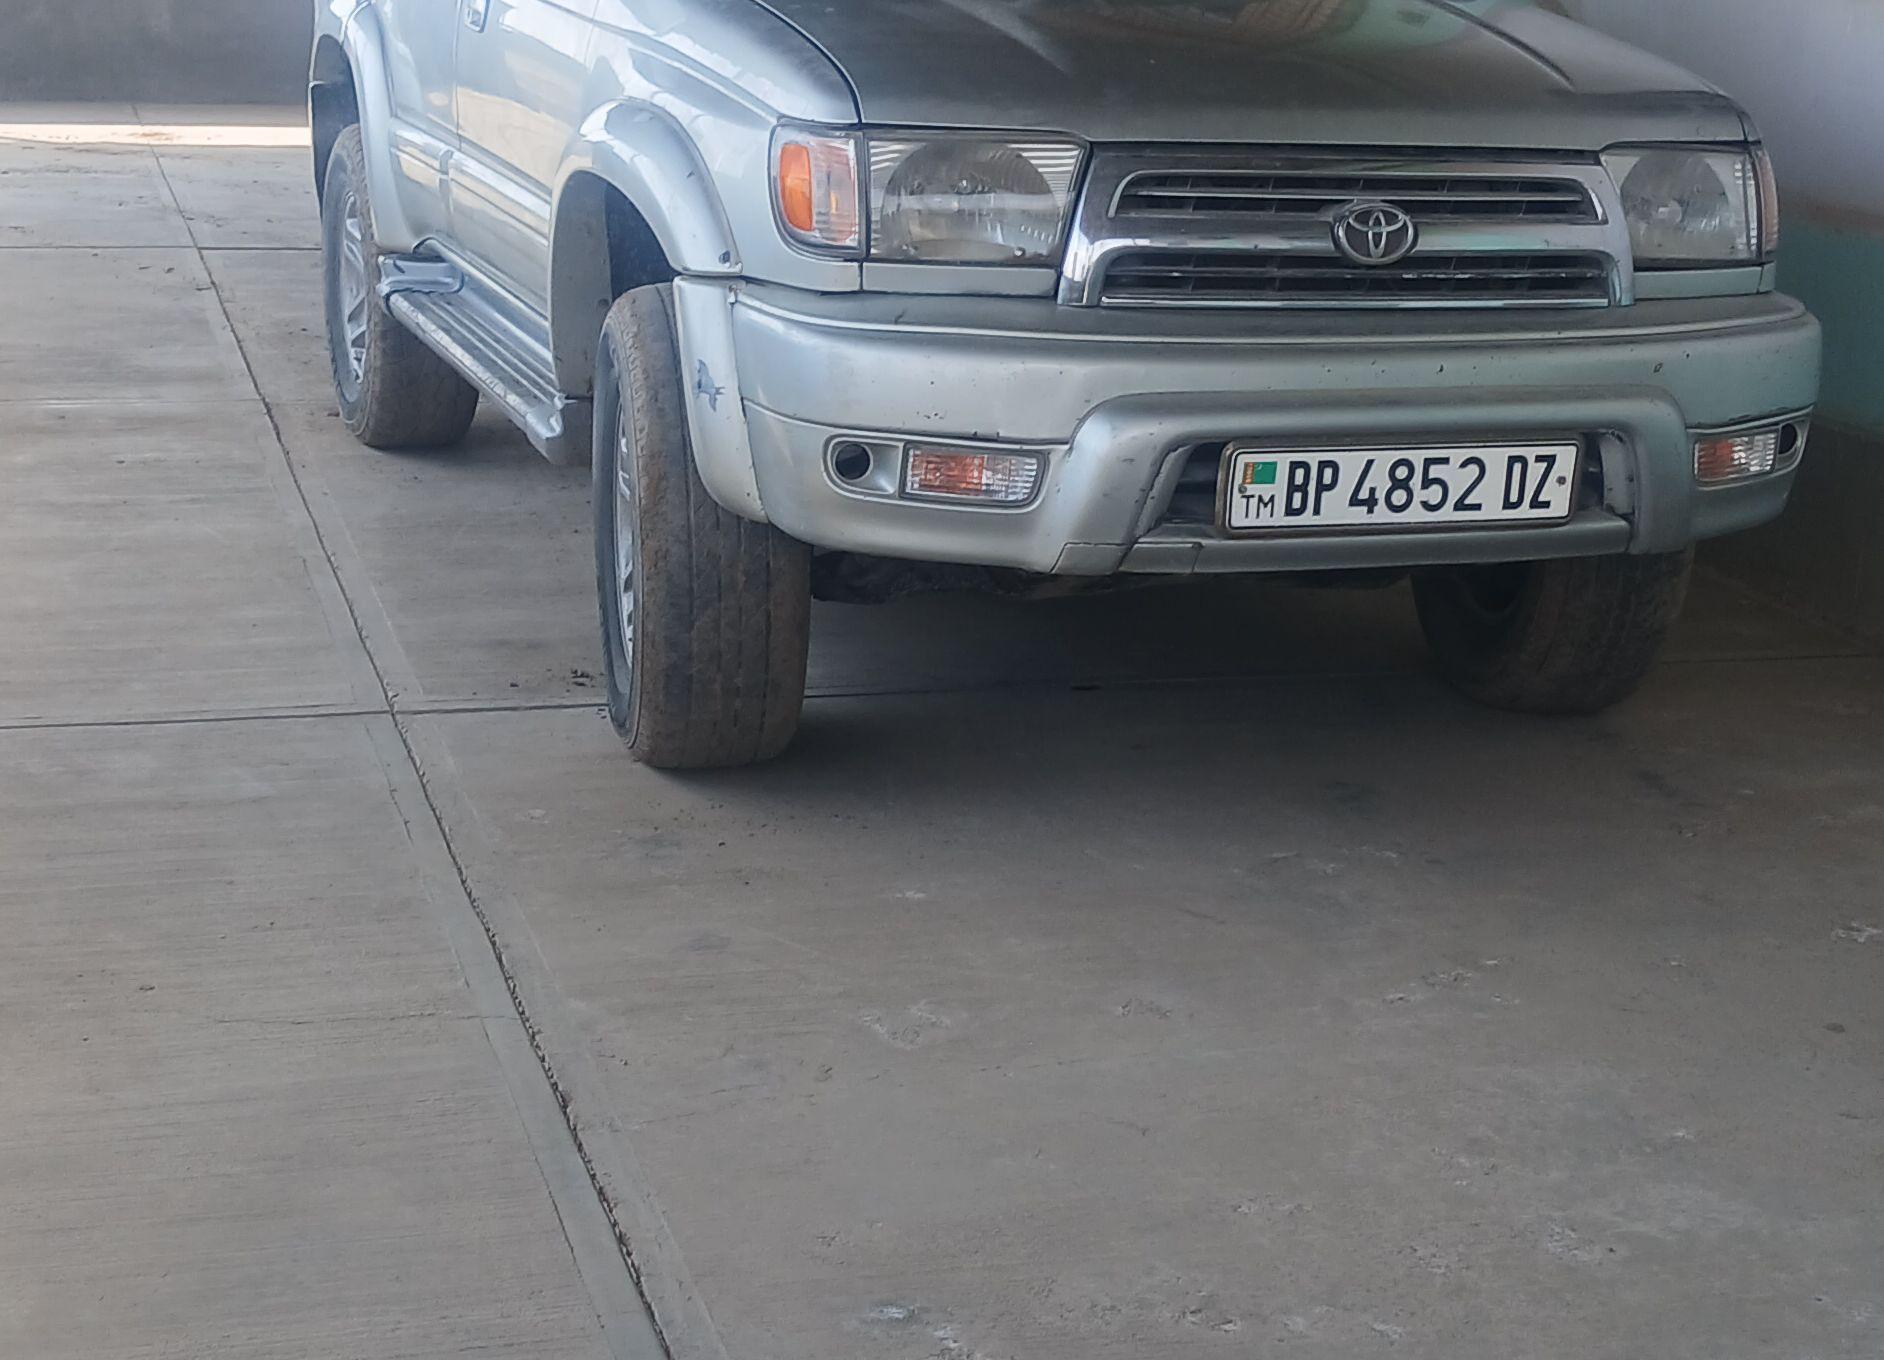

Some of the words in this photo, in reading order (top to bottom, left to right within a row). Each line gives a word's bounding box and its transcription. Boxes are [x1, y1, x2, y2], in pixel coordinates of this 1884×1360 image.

[1240, 494, 1276, 519] TM
[1283, 460, 1340, 517] BP
[1347, 456, 1487, 515] 4852
[1501, 453, 1558, 511] DZ
